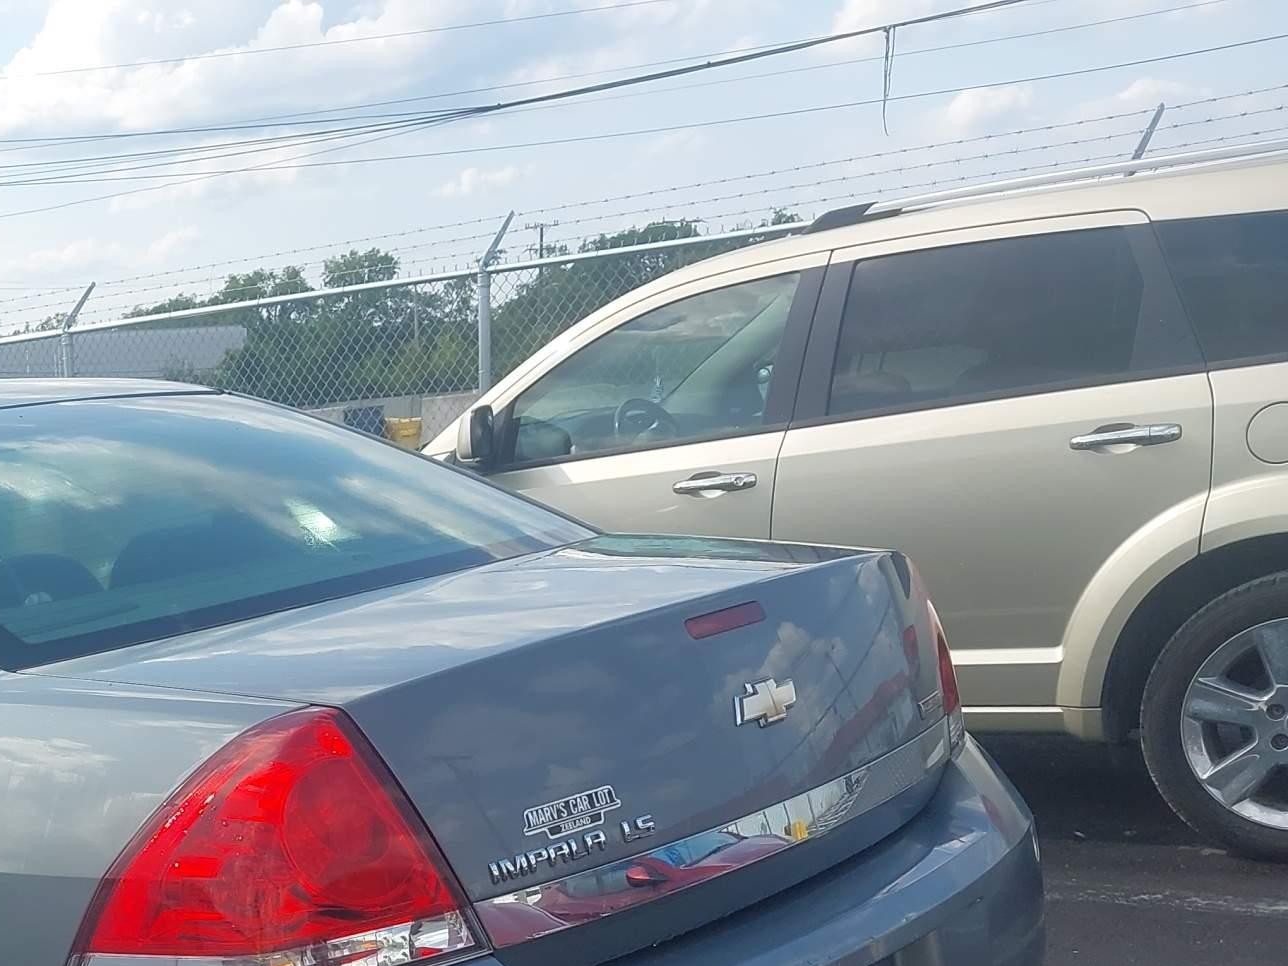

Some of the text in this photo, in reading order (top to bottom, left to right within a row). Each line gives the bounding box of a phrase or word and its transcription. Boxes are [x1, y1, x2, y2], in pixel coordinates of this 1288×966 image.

[528, 789, 611, 827] MARV'S CAR LOT
[560, 816, 591, 832] ZEELAND
[488, 814, 655, 884] IMPALA LS
